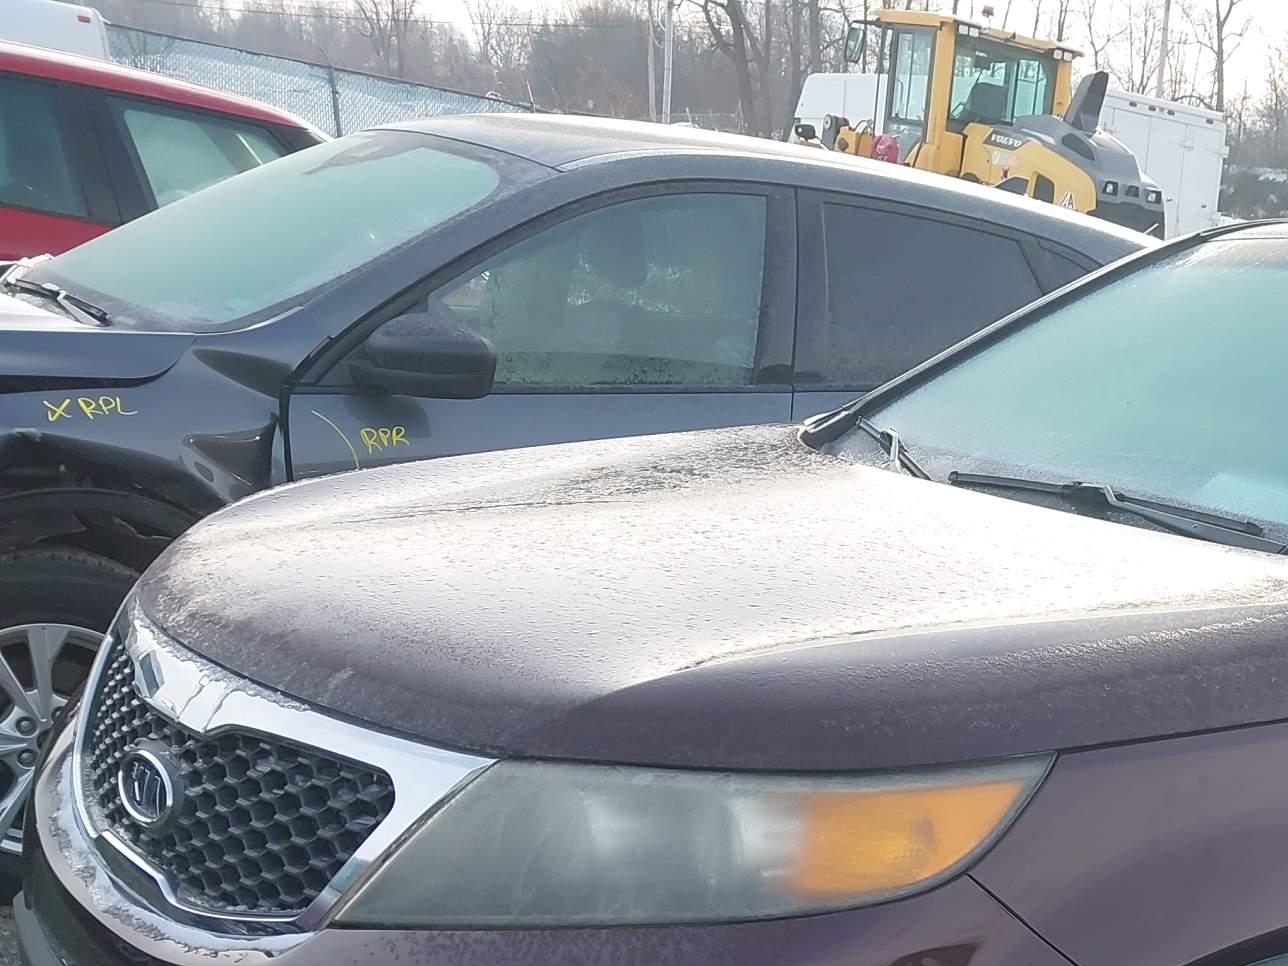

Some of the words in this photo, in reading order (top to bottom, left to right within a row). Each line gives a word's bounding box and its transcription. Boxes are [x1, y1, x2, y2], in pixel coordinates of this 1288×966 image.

[990, 133, 1023, 148] VOLVO
[78, 396, 139, 420] RPL
[359, 426, 410, 454] RPR
